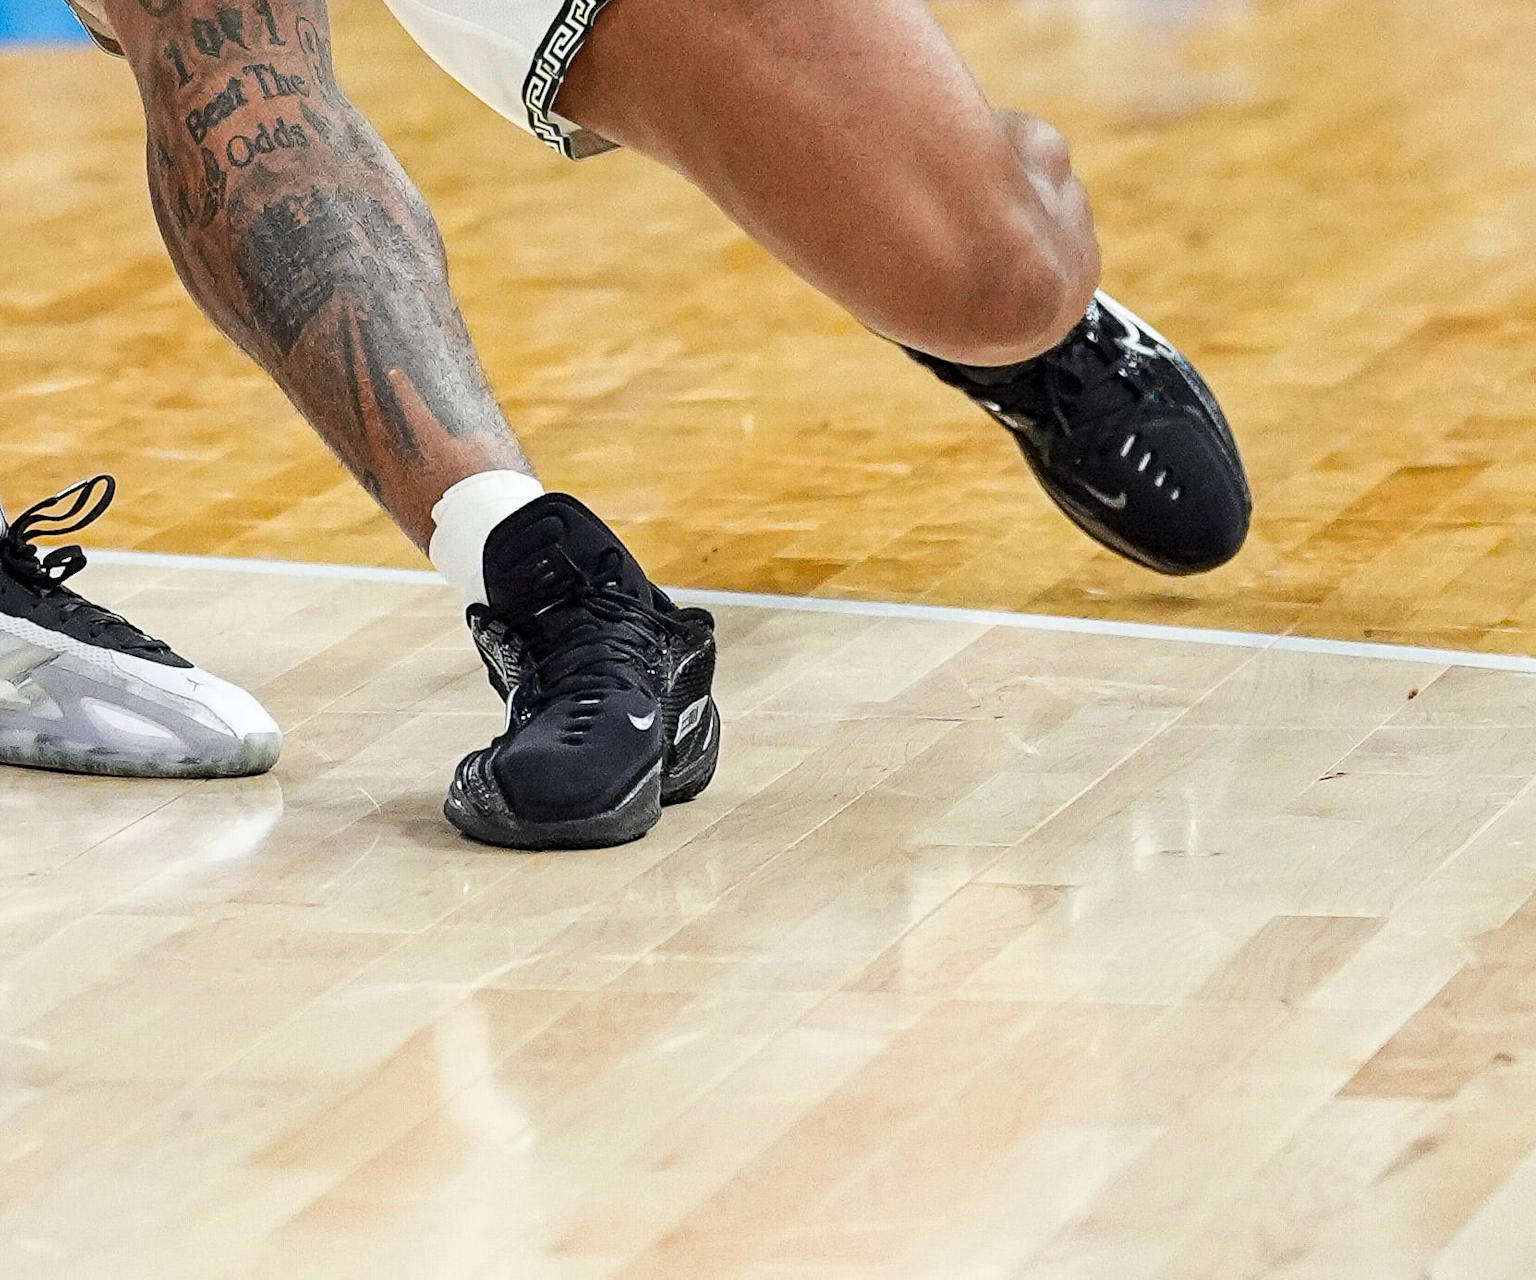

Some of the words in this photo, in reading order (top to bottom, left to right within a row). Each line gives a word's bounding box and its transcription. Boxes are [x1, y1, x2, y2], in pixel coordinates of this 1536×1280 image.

[165, 39, 194, 89] 1
[241, 62, 310, 98] The
[225, 115, 310, 168] Odds
